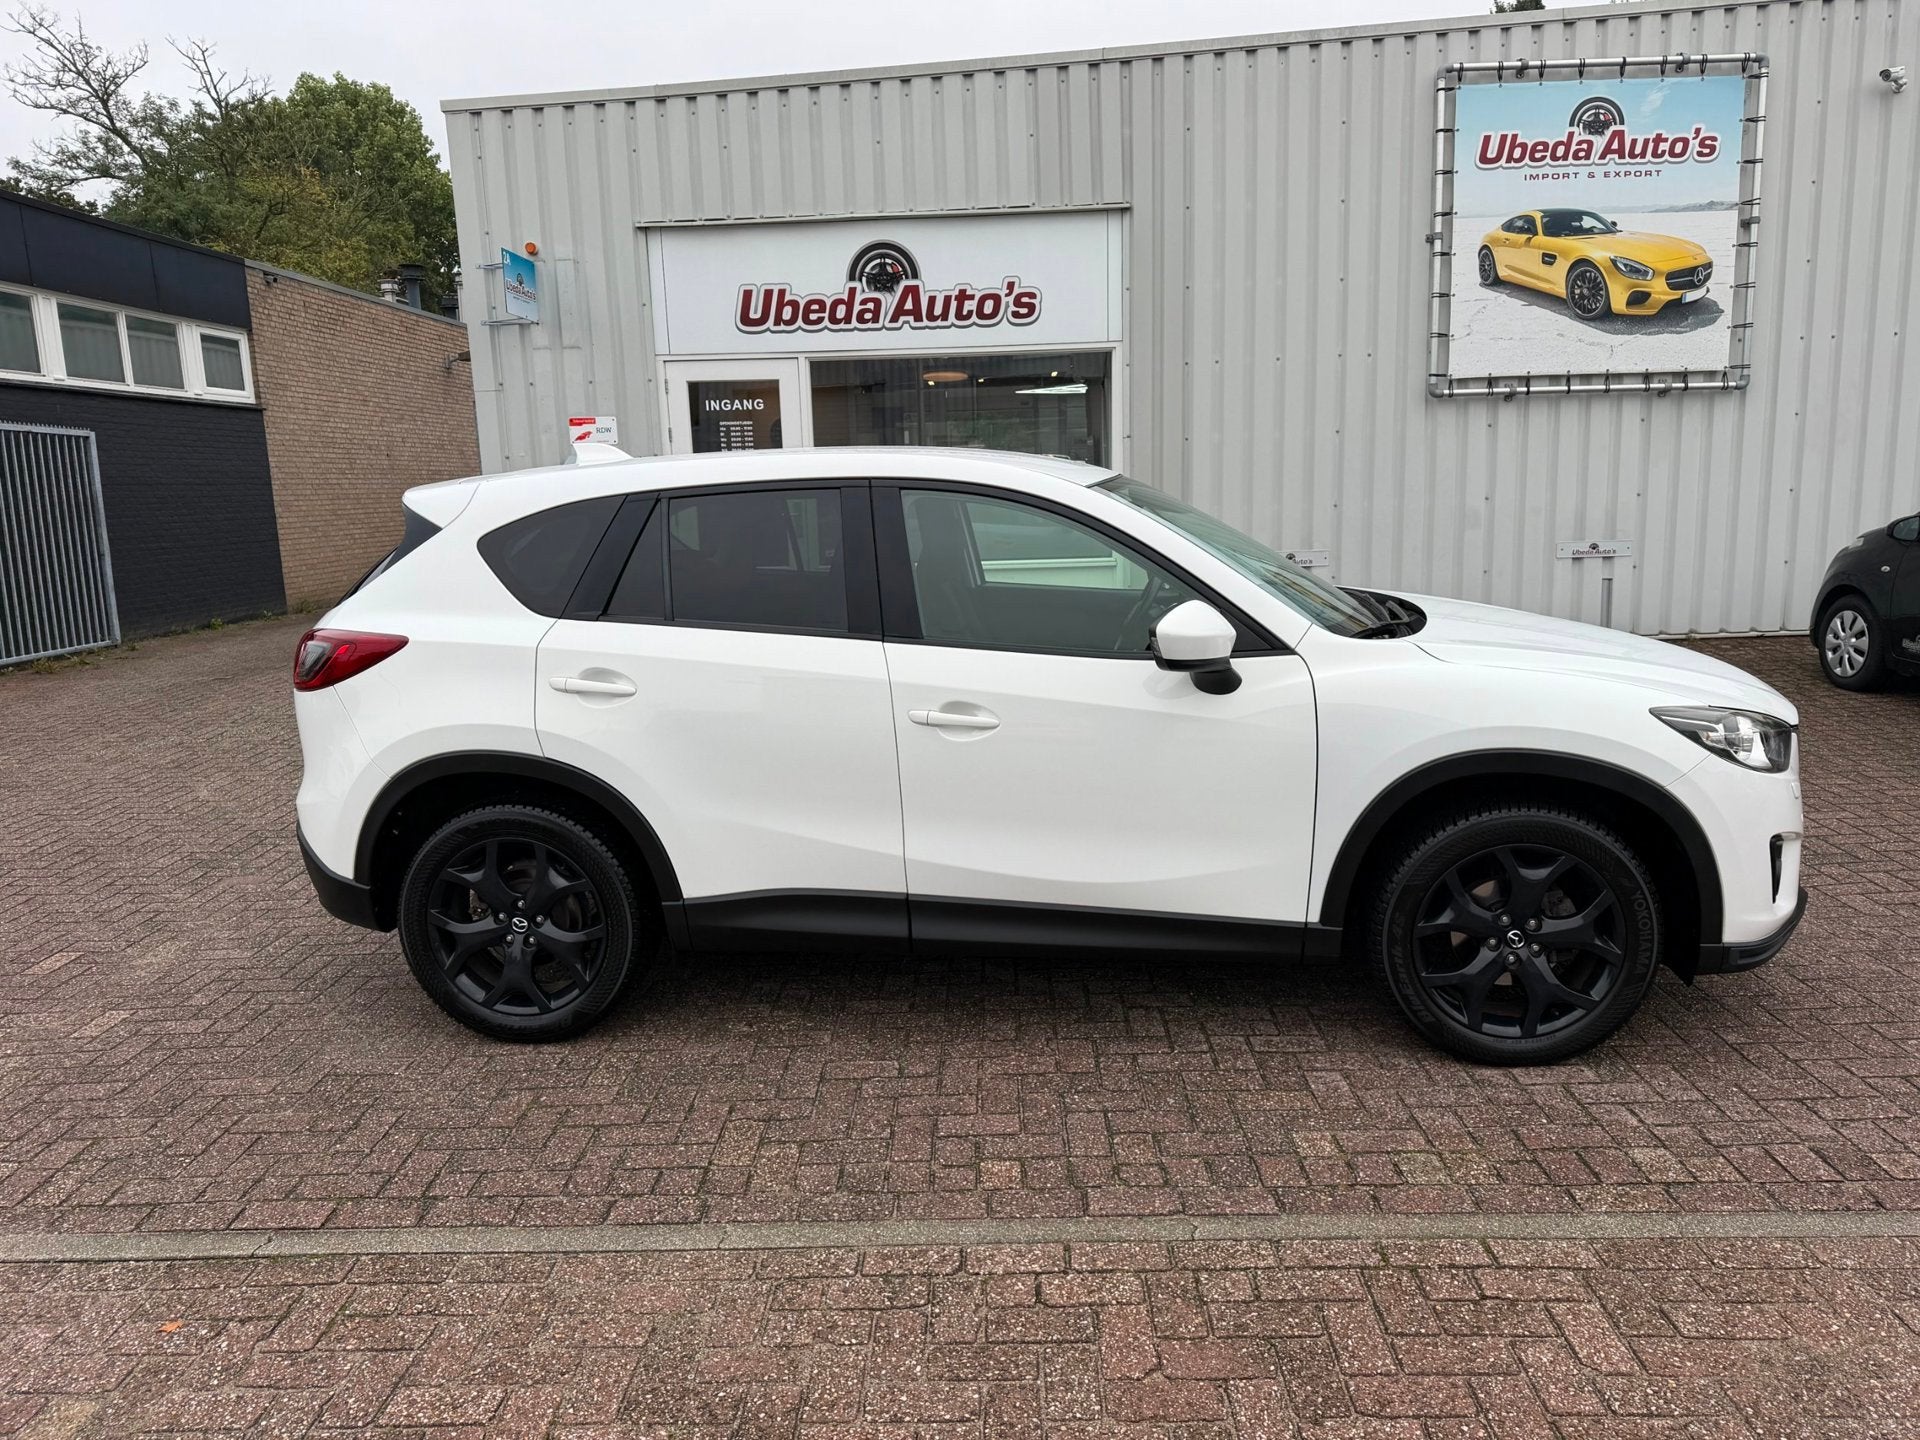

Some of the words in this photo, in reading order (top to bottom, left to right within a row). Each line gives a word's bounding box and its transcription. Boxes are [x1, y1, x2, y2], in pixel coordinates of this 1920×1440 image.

[1478, 130, 1594, 165] Ubeda
[1598, 127, 1719, 161] Auto's
[1523, 171, 1581, 181] IMPORT
[1587, 170, 1596, 179] &
[1603, 169, 1663, 178] EXPORT
[739, 286, 882, 327] Ubeda
[888, 280, 1037, 324] Auto's
[705, 398, 764, 411] INGANG
[1630, 889, 1652, 975] YOKOHAMA
